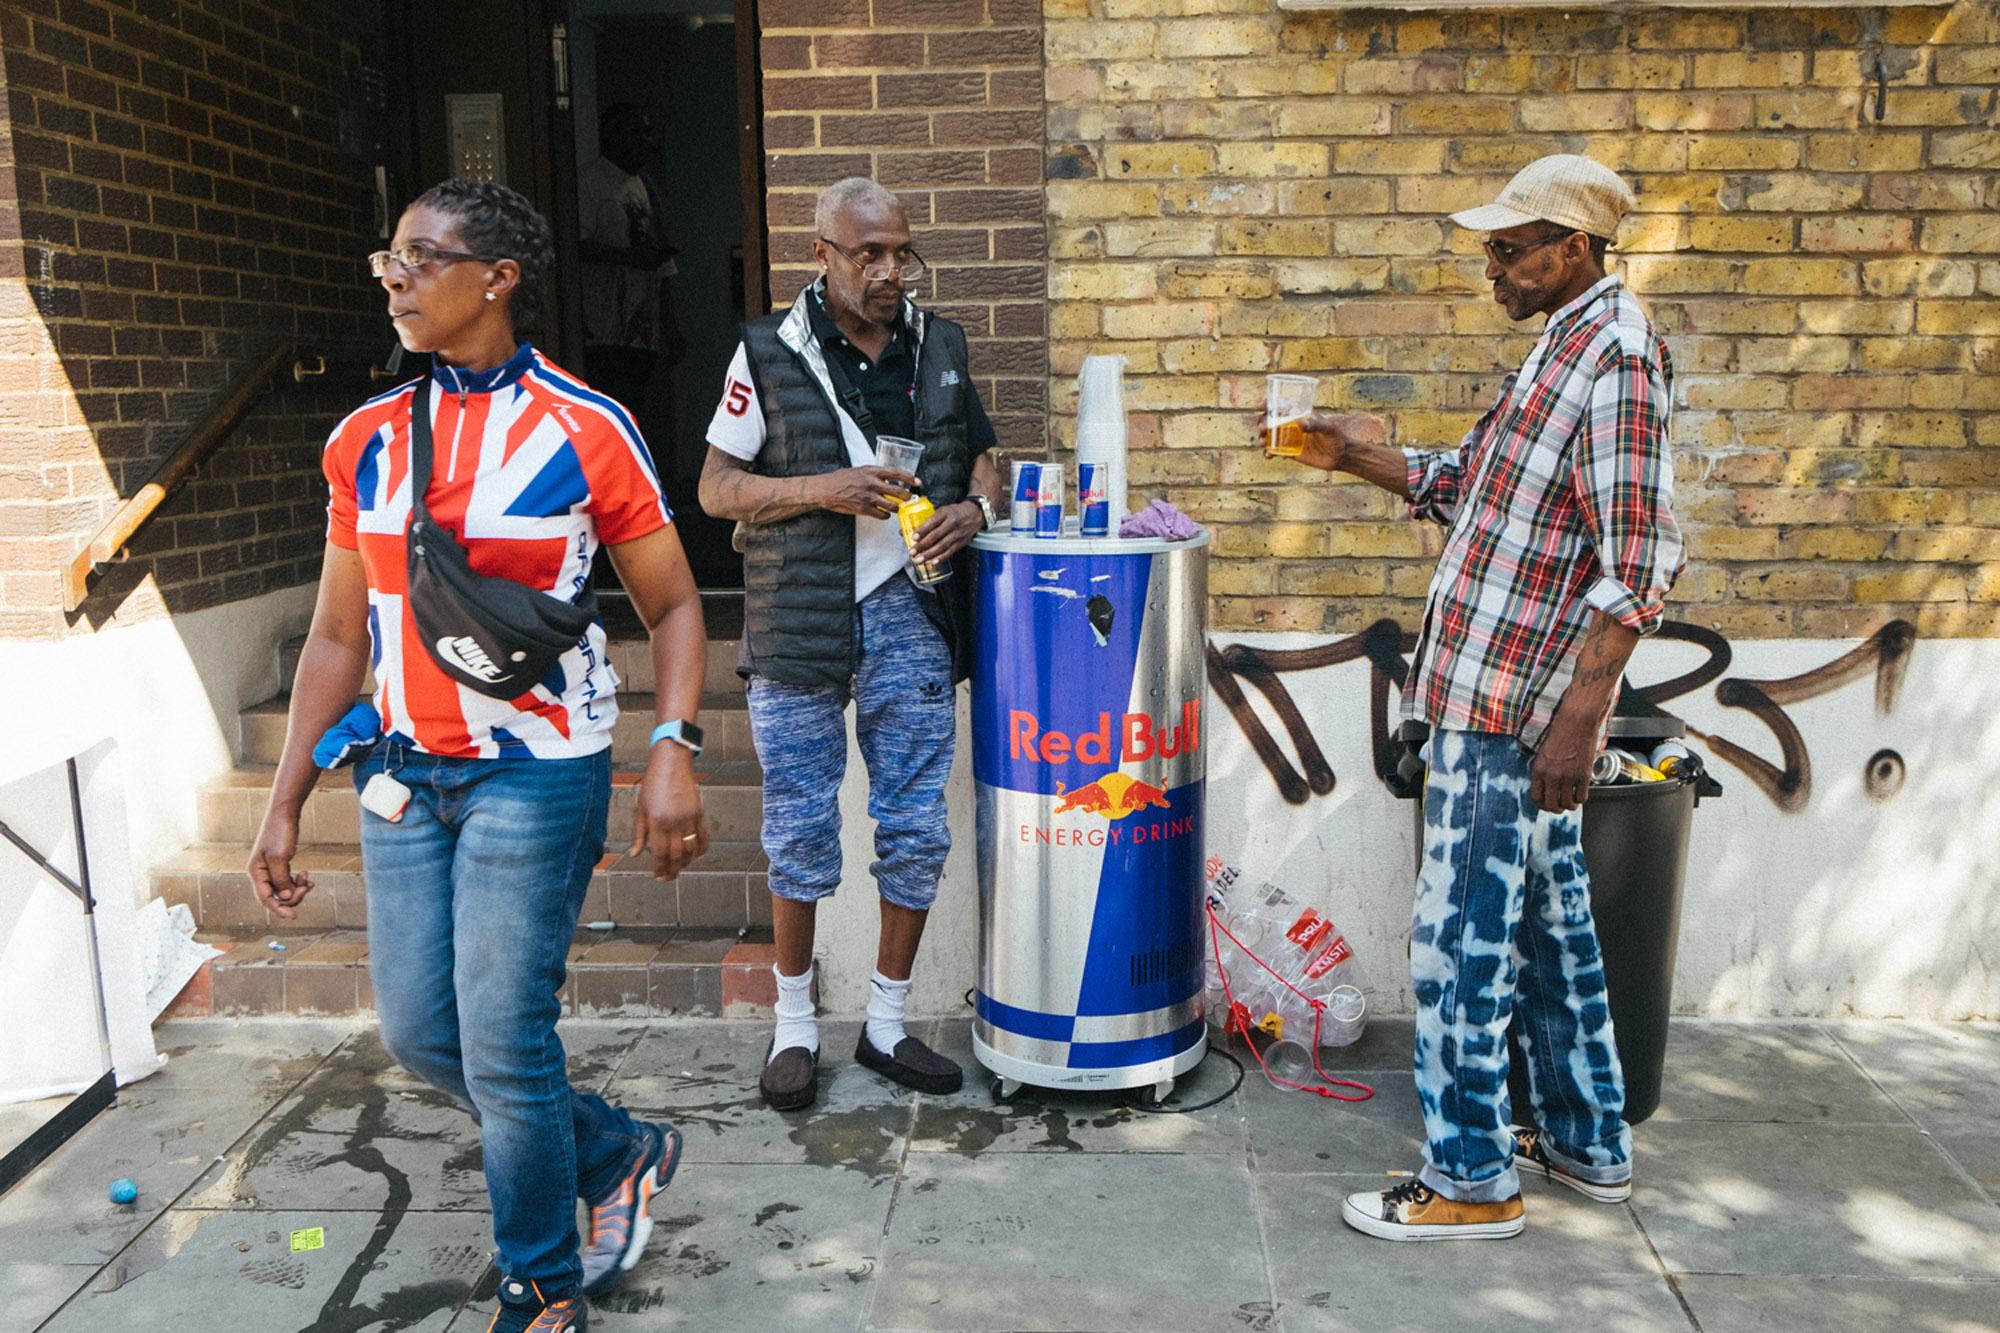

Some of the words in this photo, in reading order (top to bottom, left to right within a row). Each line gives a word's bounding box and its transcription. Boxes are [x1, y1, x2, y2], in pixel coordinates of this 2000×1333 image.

[720, 376, 752, 417] 5
[451, 635, 503, 677] NIKE
[1009, 709, 1111, 765] Red
[1121, 698, 1200, 763] Bull
[1020, 824, 1124, 847] ENERGY
[1132, 815, 1194, 844] DRINK
